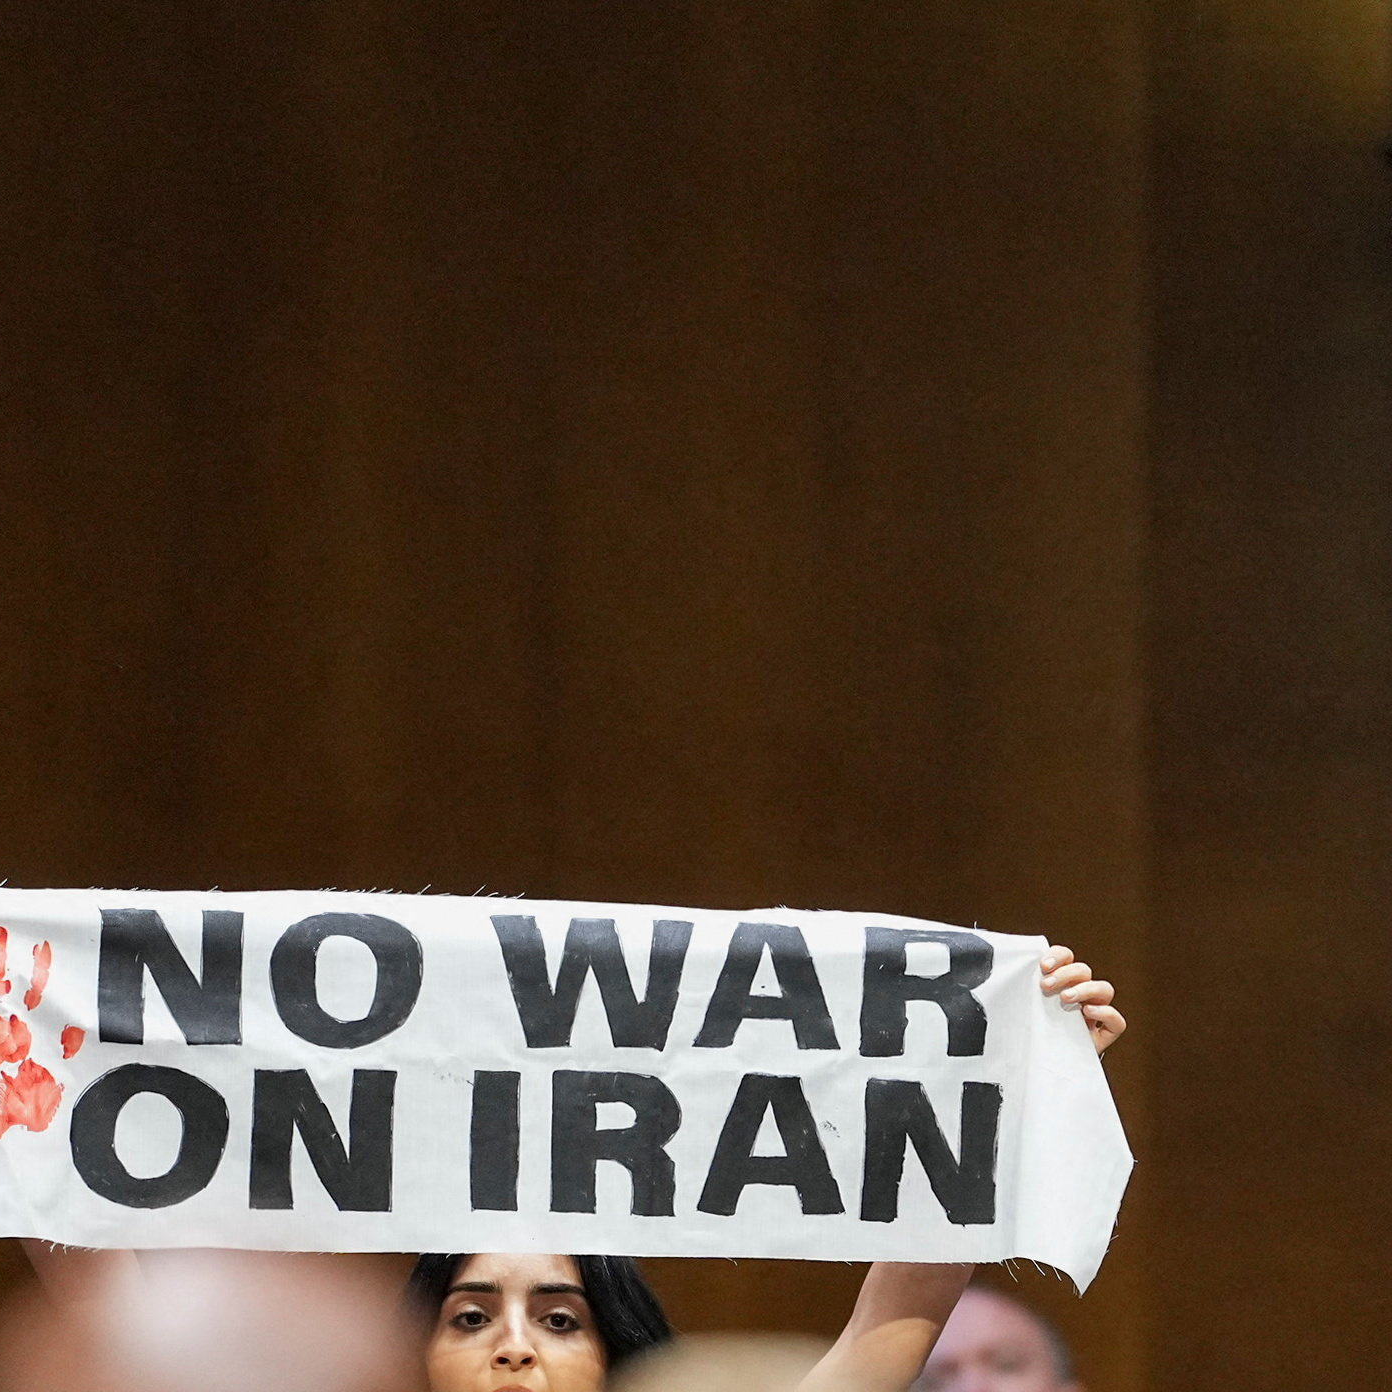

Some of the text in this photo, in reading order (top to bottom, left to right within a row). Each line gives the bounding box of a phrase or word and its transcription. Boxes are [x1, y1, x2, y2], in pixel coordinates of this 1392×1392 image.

[99, 909, 995, 1058] NO WAR
[70, 1063, 1003, 1227] ON IRAN
